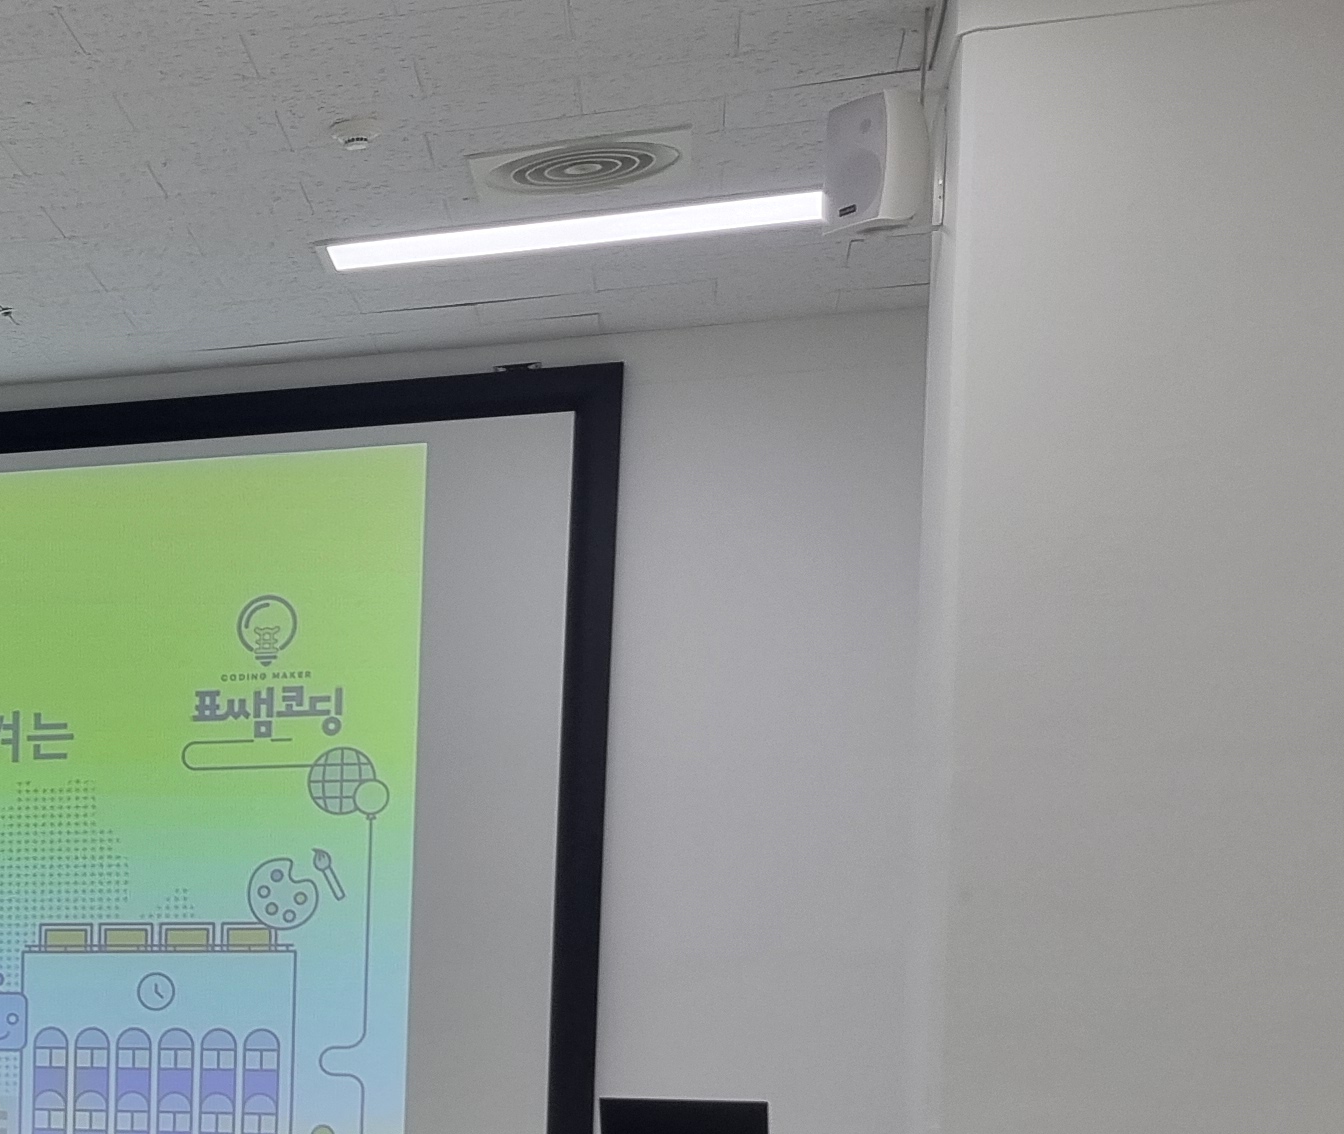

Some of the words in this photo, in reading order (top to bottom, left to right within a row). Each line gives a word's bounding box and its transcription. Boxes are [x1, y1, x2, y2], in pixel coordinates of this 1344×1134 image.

[220, 671, 267, 682] CODING
[272, 670, 312, 680] MAKER
[191, 685, 344, 739] 표쌤코딩
